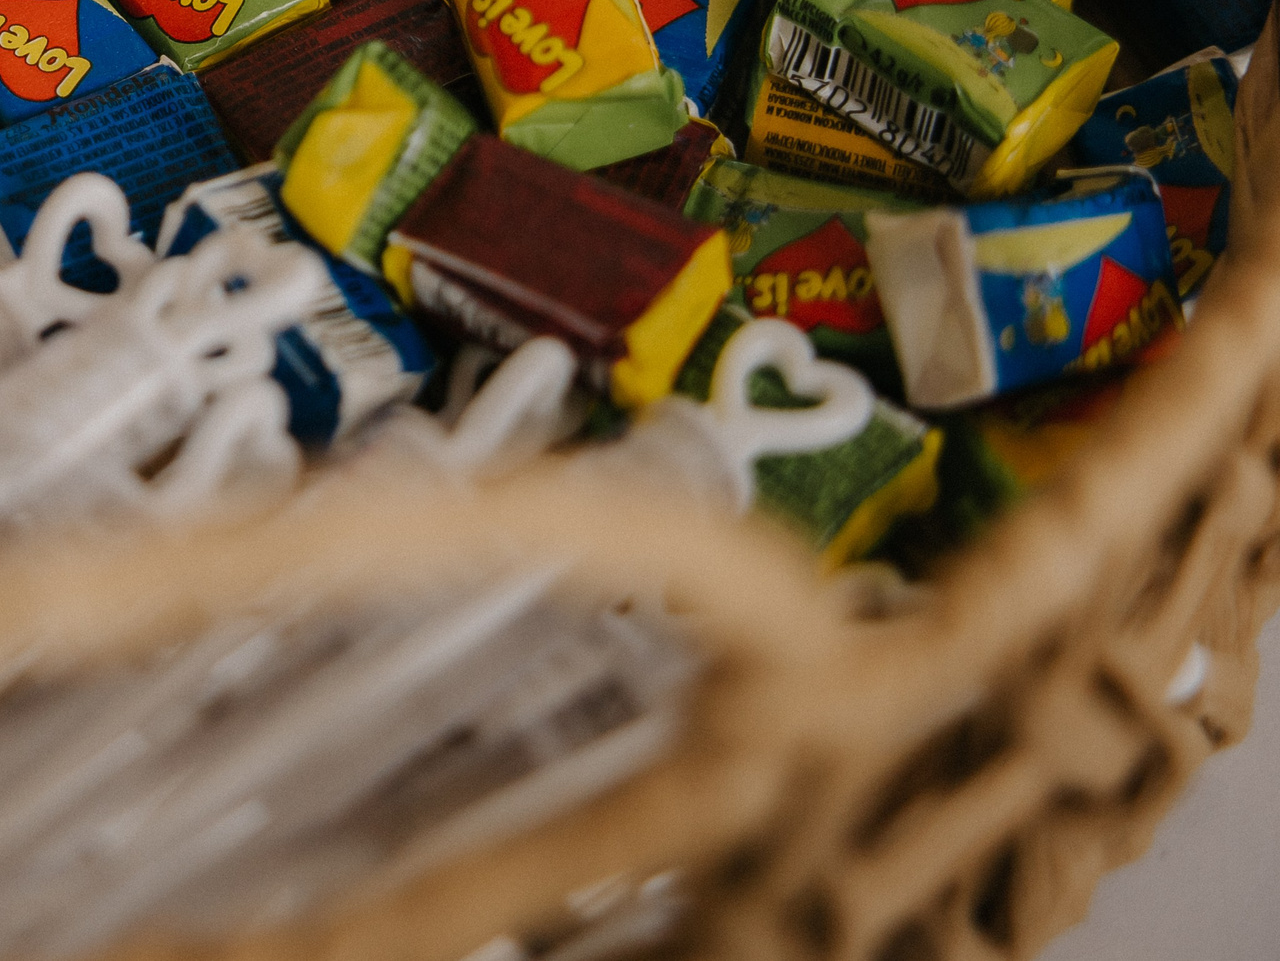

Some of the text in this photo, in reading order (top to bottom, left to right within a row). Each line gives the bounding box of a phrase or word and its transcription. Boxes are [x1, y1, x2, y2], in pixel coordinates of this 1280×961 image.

[498, 6, 585, 95] Love
[126, 87, 176, 116] MADDELERI
[774, 106, 812, 124] КОКОСА
[793, 265, 876, 303] ove
